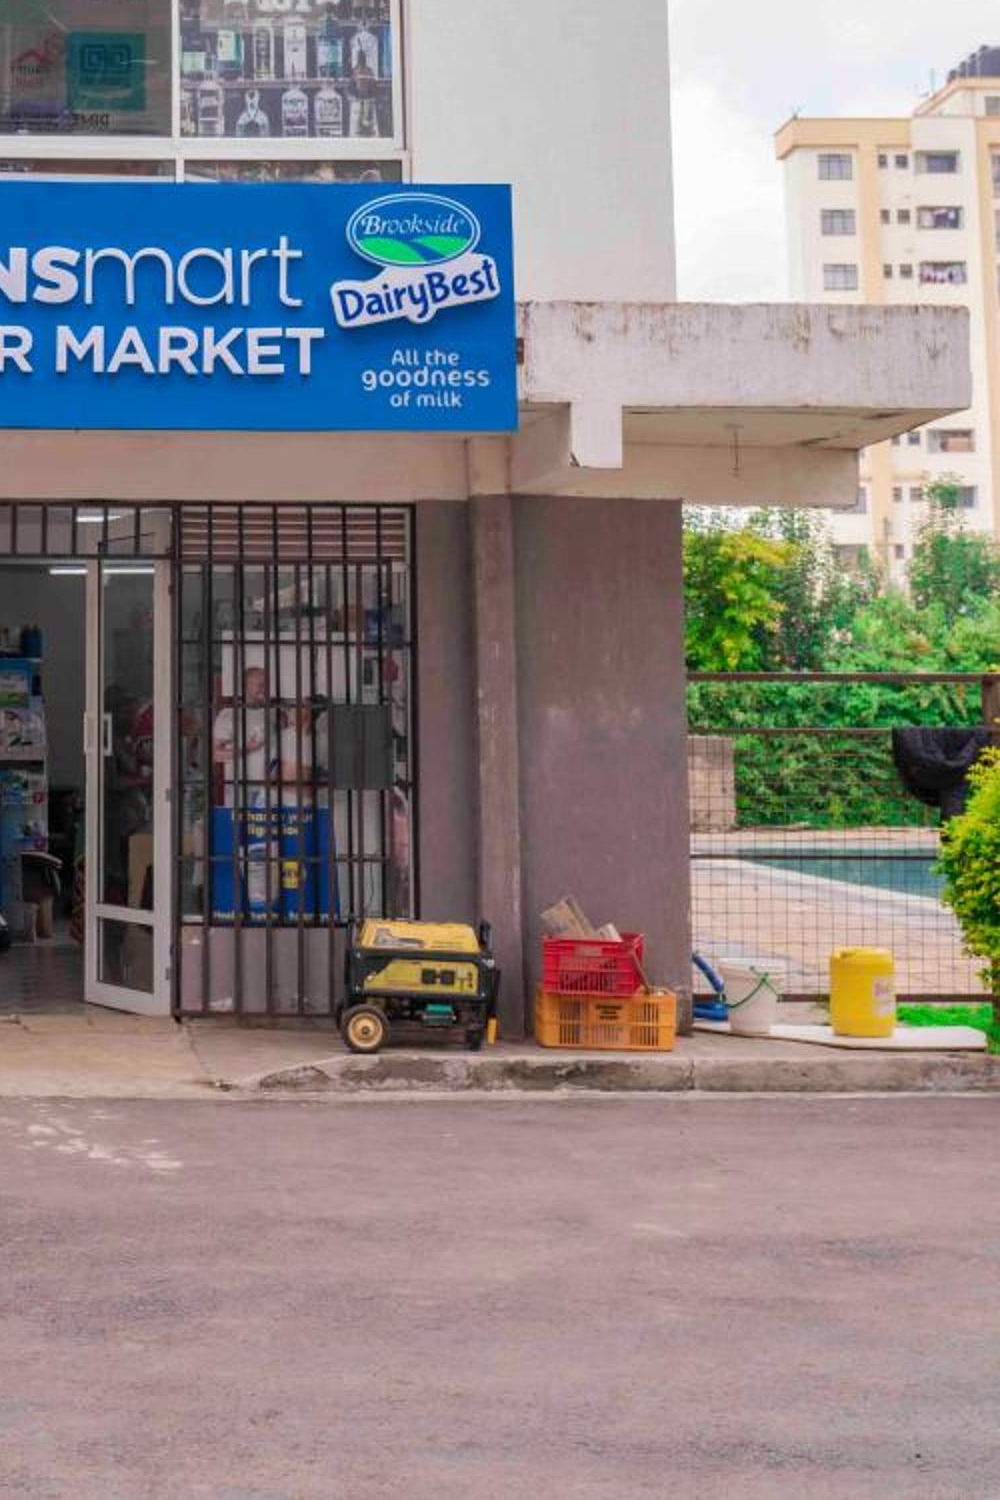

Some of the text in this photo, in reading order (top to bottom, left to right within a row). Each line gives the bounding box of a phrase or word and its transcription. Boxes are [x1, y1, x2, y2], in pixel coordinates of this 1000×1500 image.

[360, 214, 465, 235] Brookside
[338, 258, 497, 322] DairyBest
[55, 326, 325, 375] MARKET
[391, 349, 460, 366] All the
[361, 366, 490, 391] goodness
[390, 390, 463, 408] of milk
